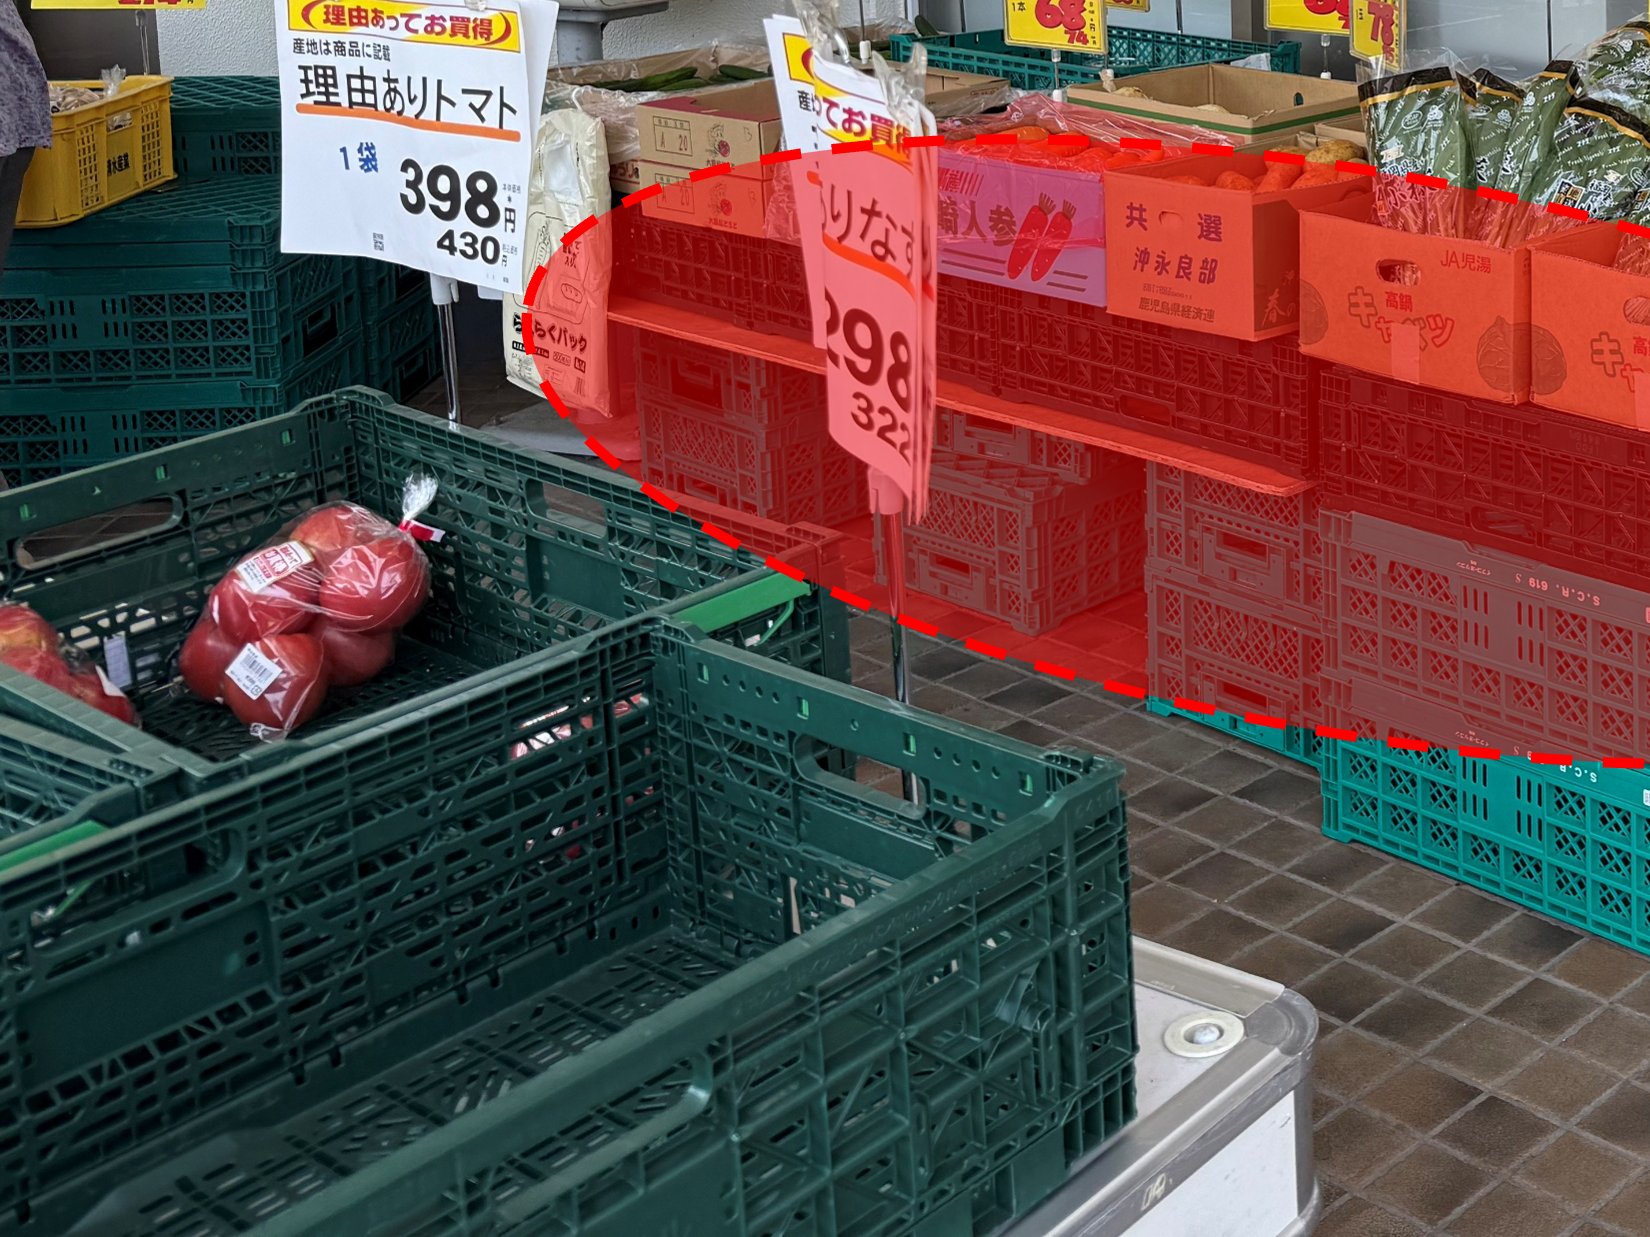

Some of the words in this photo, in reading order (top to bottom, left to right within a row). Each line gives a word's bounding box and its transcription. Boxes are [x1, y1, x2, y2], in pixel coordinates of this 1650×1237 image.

[1011, 1, 1026, 12] 1本
[322, 3, 495, 43] 理由あってお買得
[292, 37, 391, 63] 産地は商品に記載
[297, 64, 518, 130] 理由ありトマト
[678, 133, 689, 152] 20
[339, 141, 379, 174] 1袋
[399, 157, 502, 229] 398
[503, 206, 517, 234] 円
[1125, 202, 1224, 244] 共選
[436, 228, 501, 266] 430
[1132, 245, 1220, 286] 沖永良部
[1440, 248, 1493, 276] JA児湯
[1137, 296, 1216, 324] 鹿児島県経済連
[1384, 290, 1414, 314] 高鍋
[1528, 577, 1549, 592] 619
